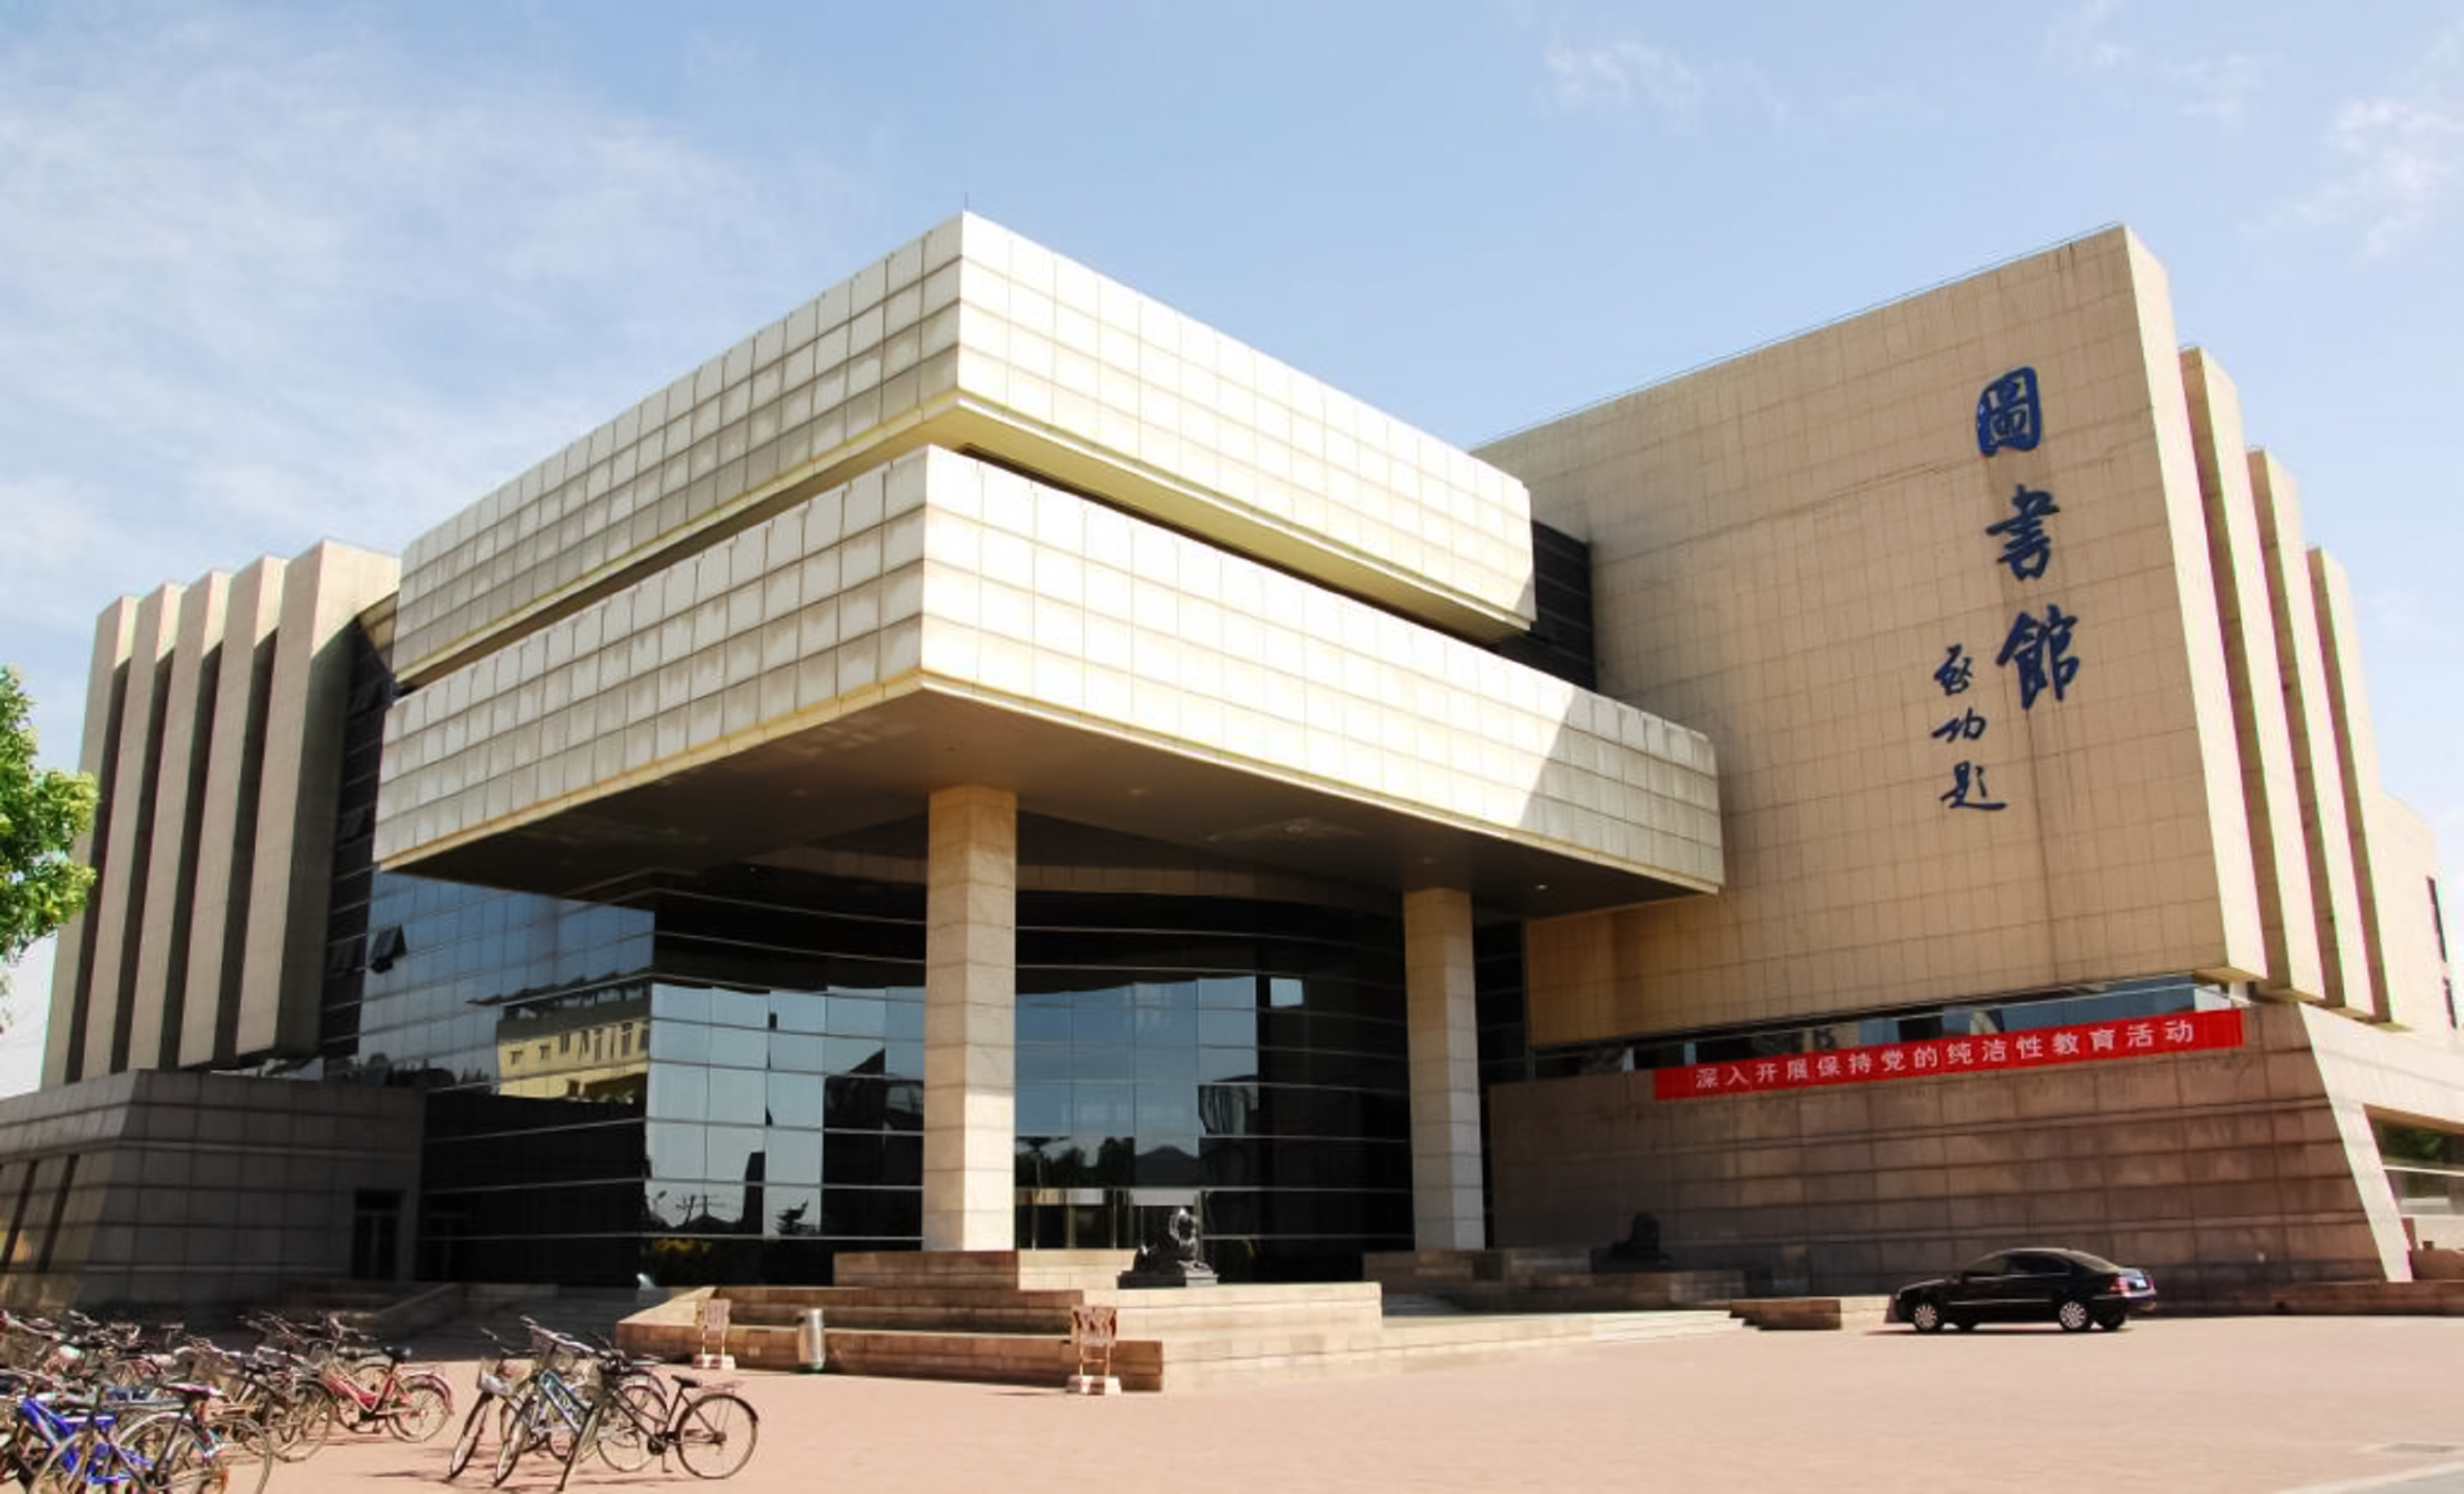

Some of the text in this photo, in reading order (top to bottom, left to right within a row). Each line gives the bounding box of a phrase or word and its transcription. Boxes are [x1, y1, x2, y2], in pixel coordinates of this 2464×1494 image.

[1694, 1019, 2195, 1089] 深入开展保持党的纯洁性教育活动
